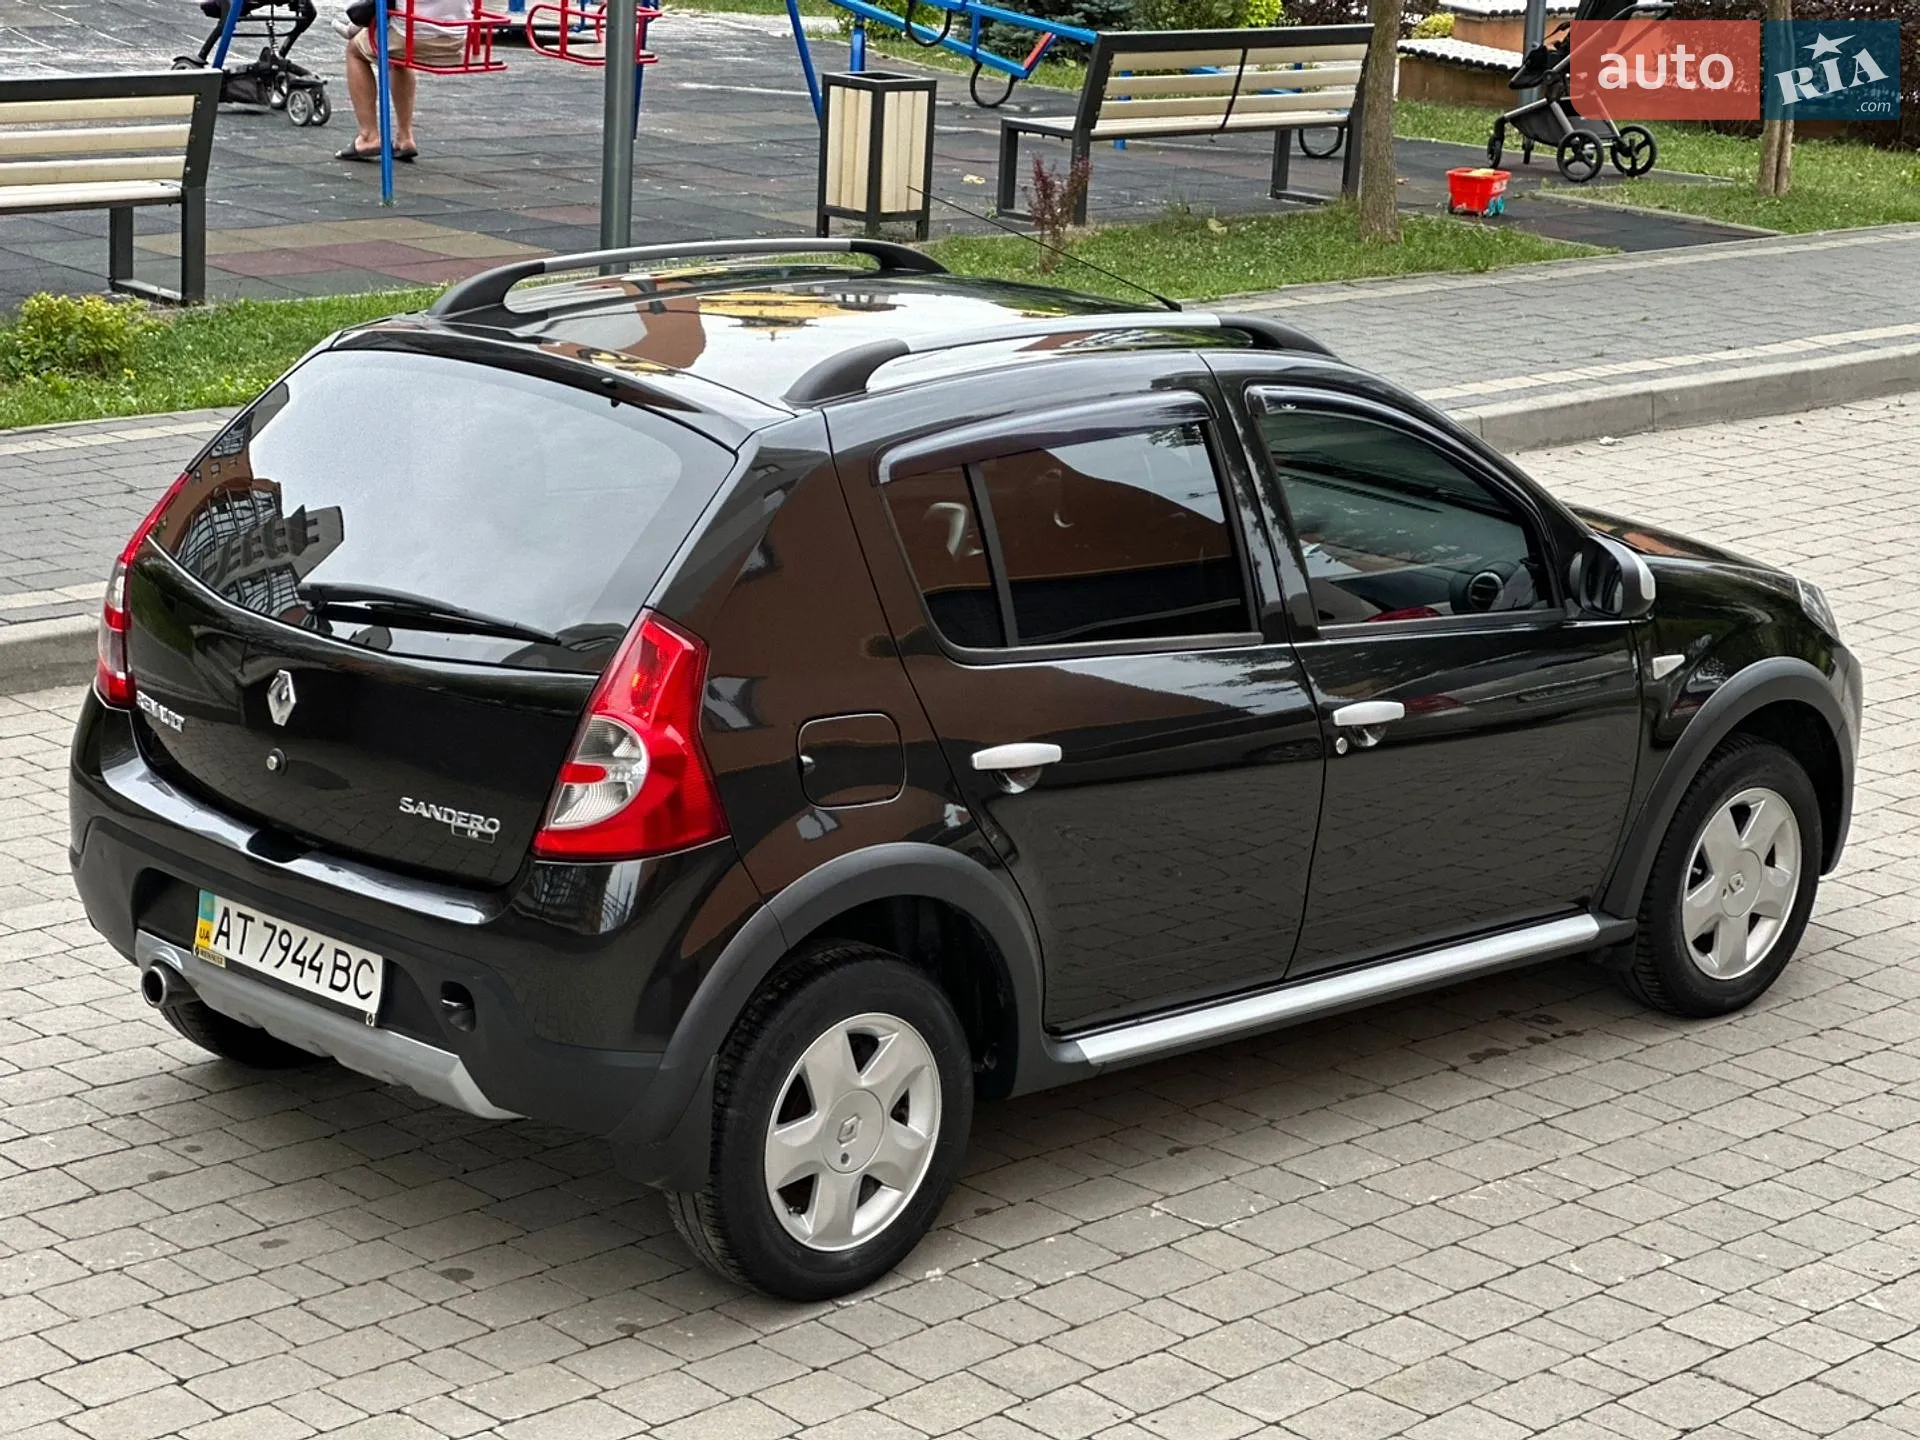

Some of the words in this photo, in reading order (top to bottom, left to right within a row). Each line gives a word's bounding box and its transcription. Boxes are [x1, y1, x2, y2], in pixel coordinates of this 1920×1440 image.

[398, 796, 501, 834] SANDERO
[198, 927, 211, 943] UA
[213, 906, 255, 955] AT
[259, 921, 325, 984] 7944
[328, 947, 375, 1000] BC
